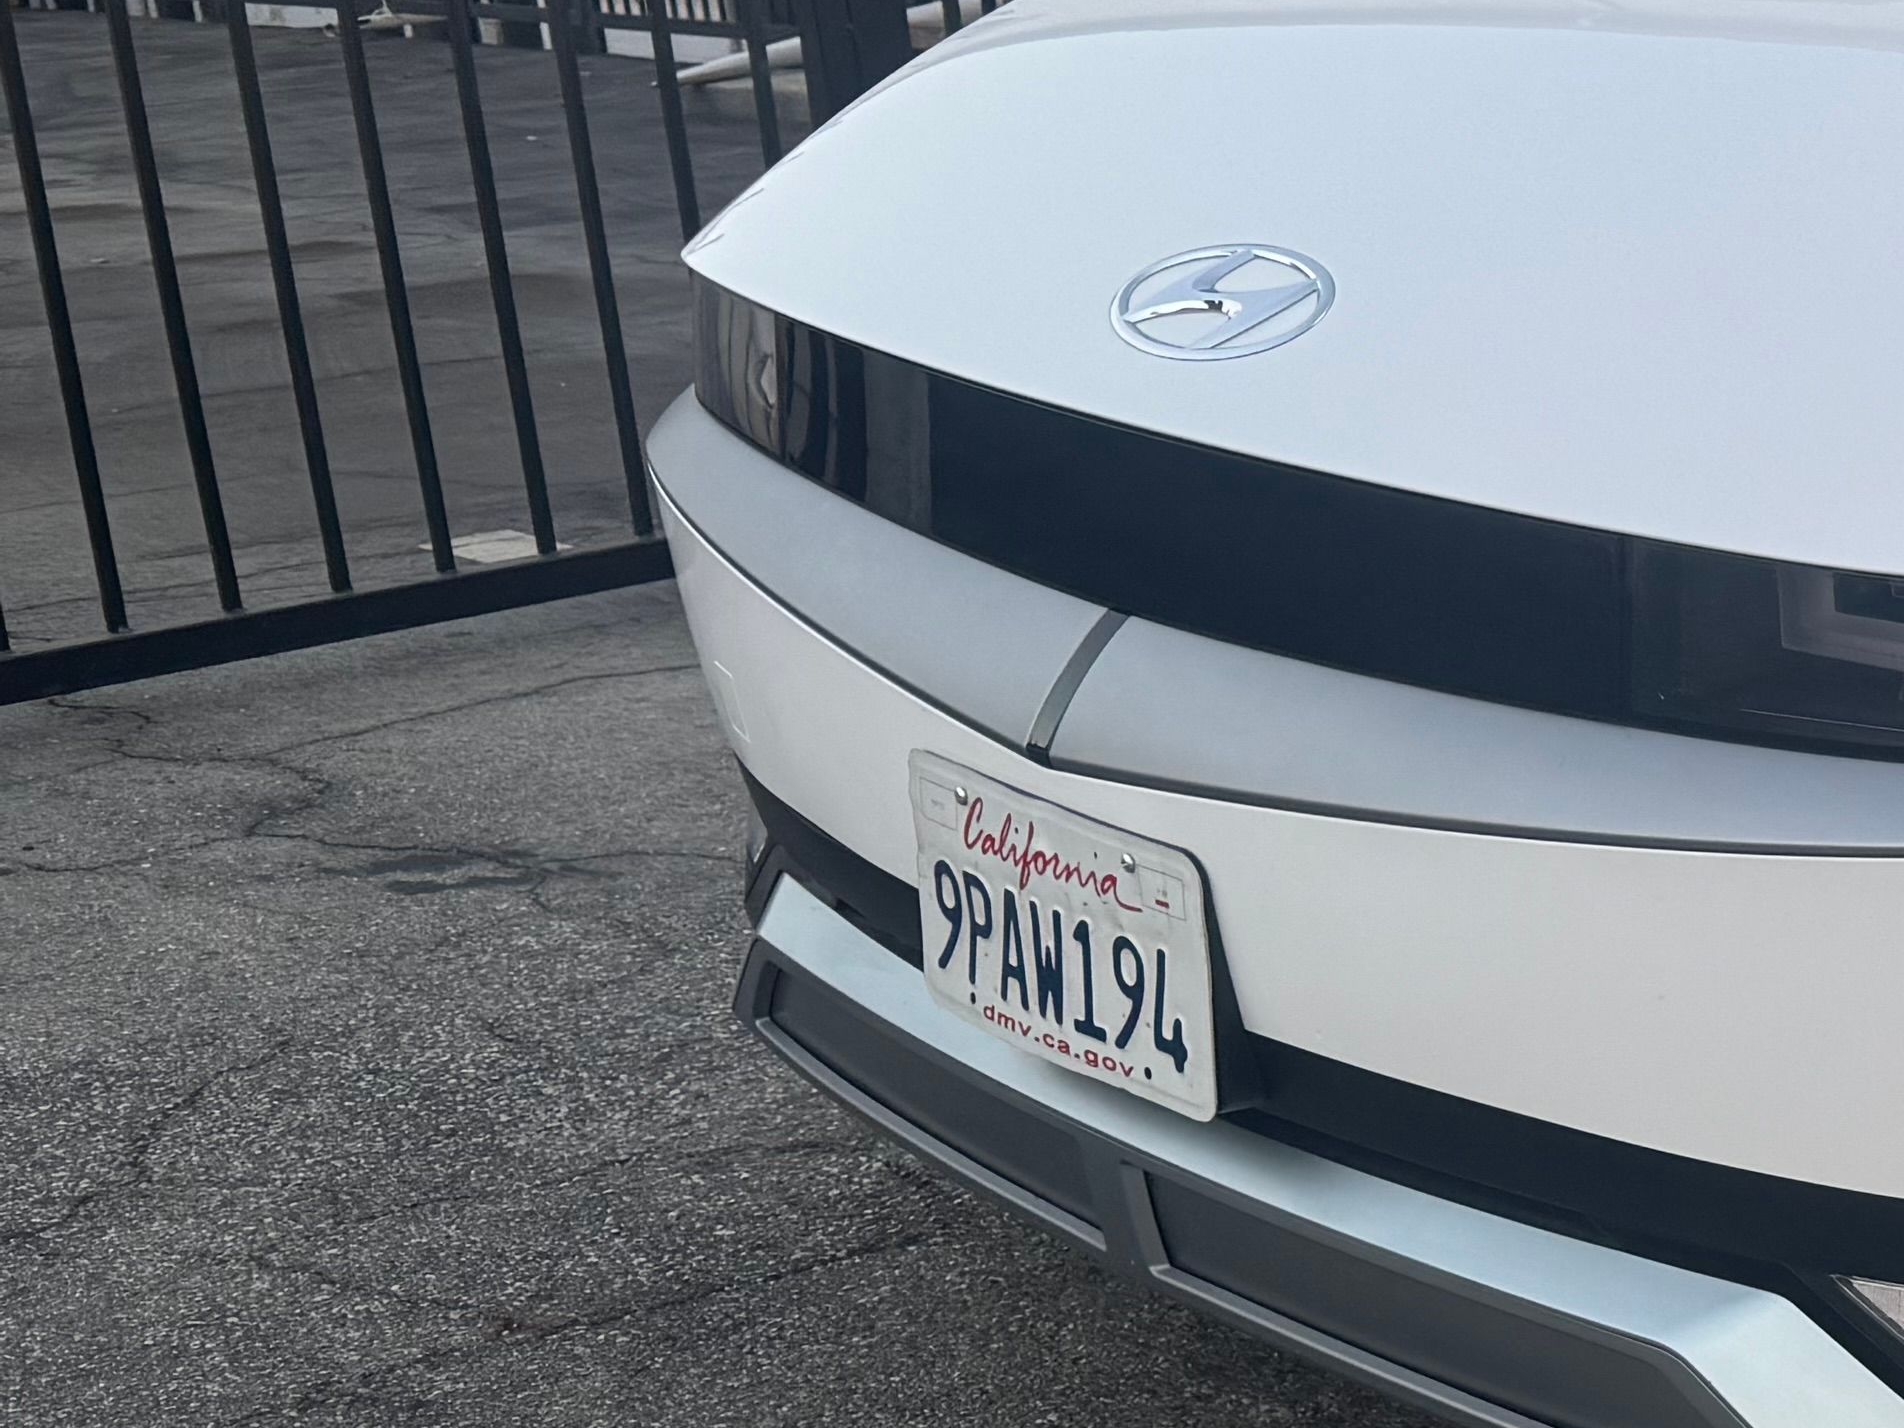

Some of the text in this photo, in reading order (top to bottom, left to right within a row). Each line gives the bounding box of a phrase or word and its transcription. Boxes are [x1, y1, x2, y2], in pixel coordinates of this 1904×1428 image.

[963, 796, 1144, 913] California
[934, 859, 1189, 1074] 9PAW194
[982, 1003, 1136, 1078] dmv.ca.gov
